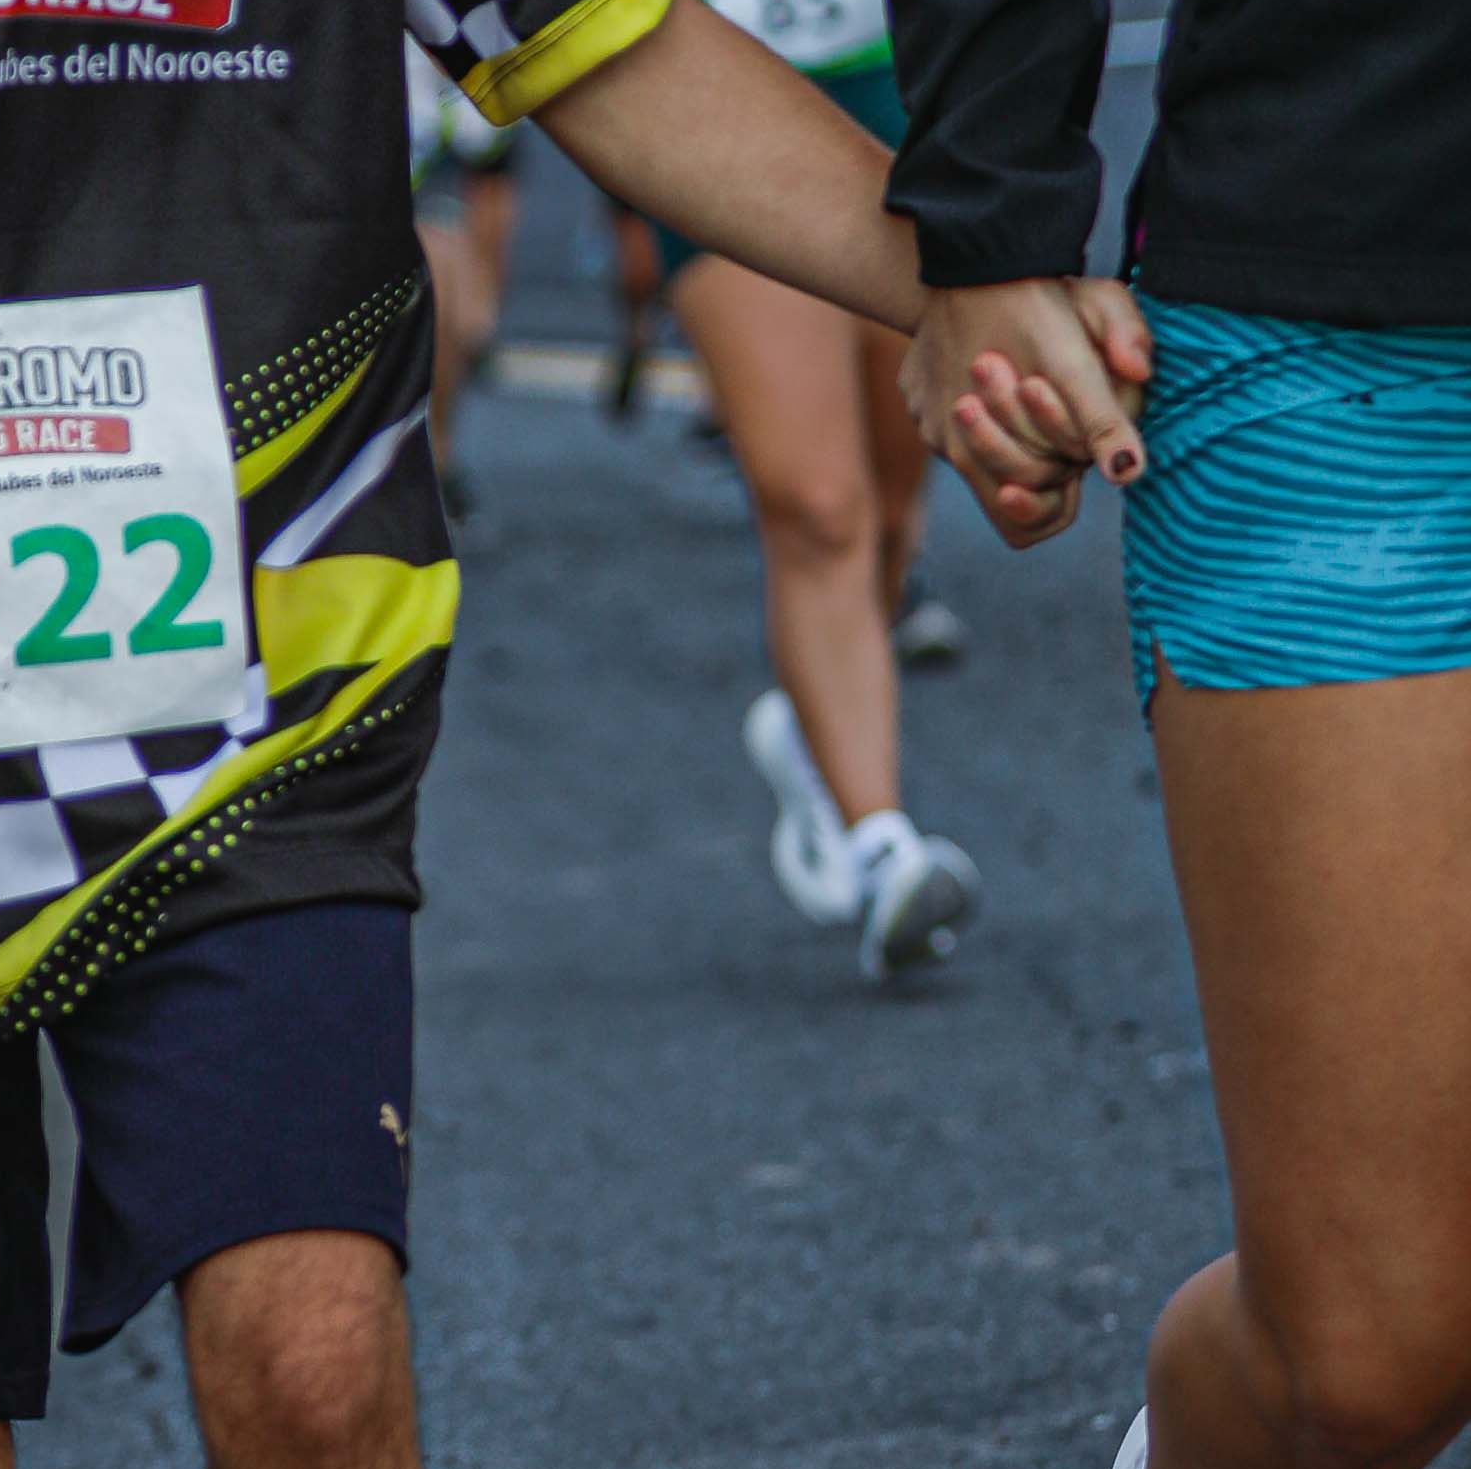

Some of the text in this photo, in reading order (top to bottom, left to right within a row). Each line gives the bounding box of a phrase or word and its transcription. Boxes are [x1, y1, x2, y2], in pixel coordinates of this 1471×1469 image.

[64, 42, 118, 82] del
[128, 42, 290, 79] Noroeste
[16, 417, 98, 453] RACE
[47, 467, 75, 488] del
[80, 460, 163, 482] Noroeste
